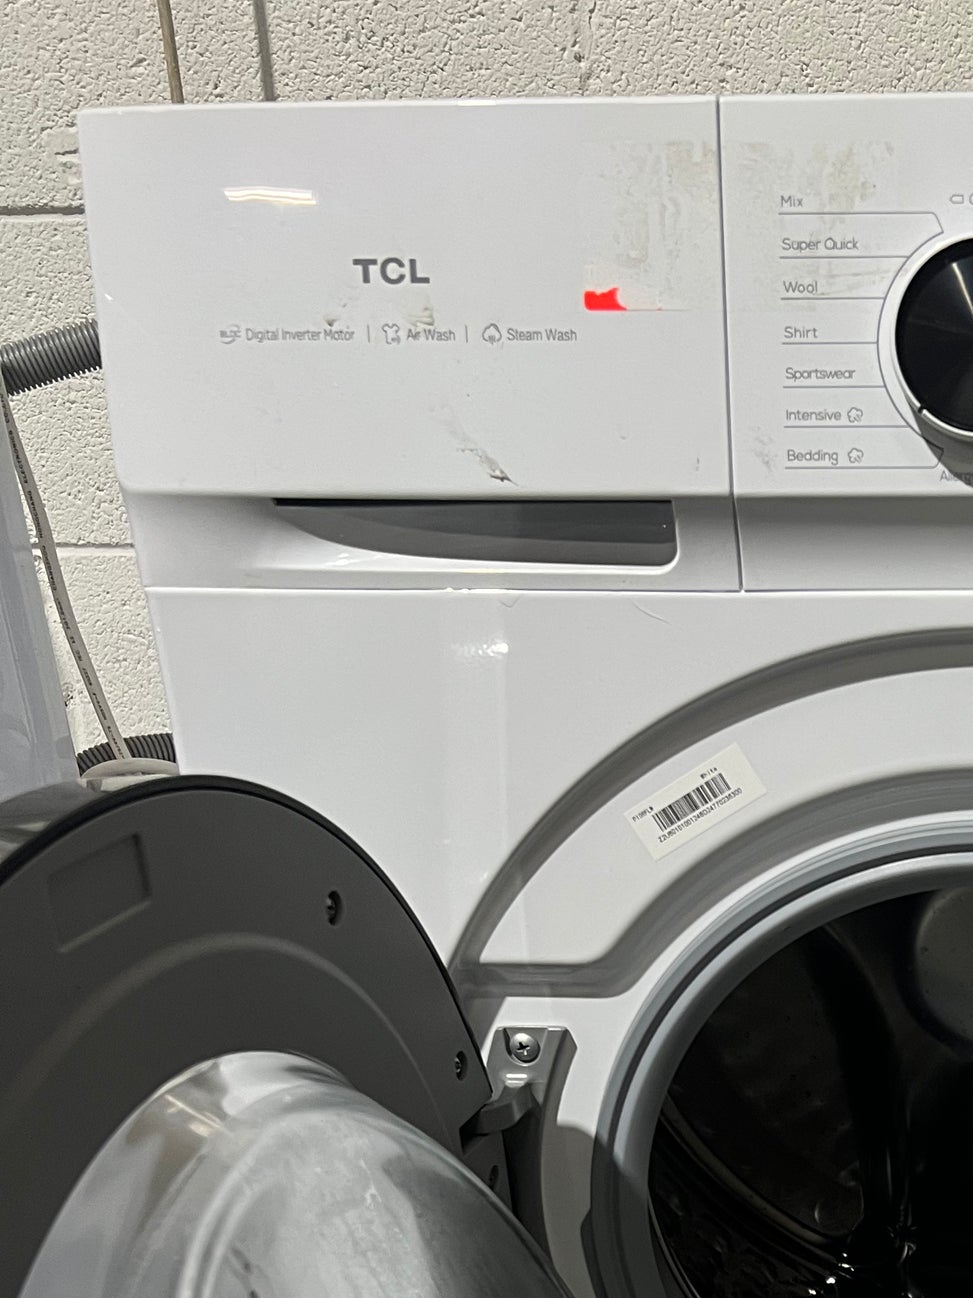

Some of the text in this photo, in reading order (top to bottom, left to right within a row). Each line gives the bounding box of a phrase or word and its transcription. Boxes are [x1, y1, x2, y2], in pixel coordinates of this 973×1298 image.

[780, 195, 803, 208] Mix
[781, 237, 859, 254] Super Quick
[352, 257, 431, 285] TCL
[783, 280, 819, 294] Wool
[245, 327, 279, 344] Digital
[281, 327, 322, 341] Inverter
[323, 327, 355, 341] Motor
[423, 328, 456, 342] Wash
[506, 327, 578, 342] Steam Wash
[784, 326, 818, 340] Shirt
[785, 367, 856, 383] Sportswear
[785, 409, 842, 422] Intensive
[787, 449, 839, 466] Bedding
